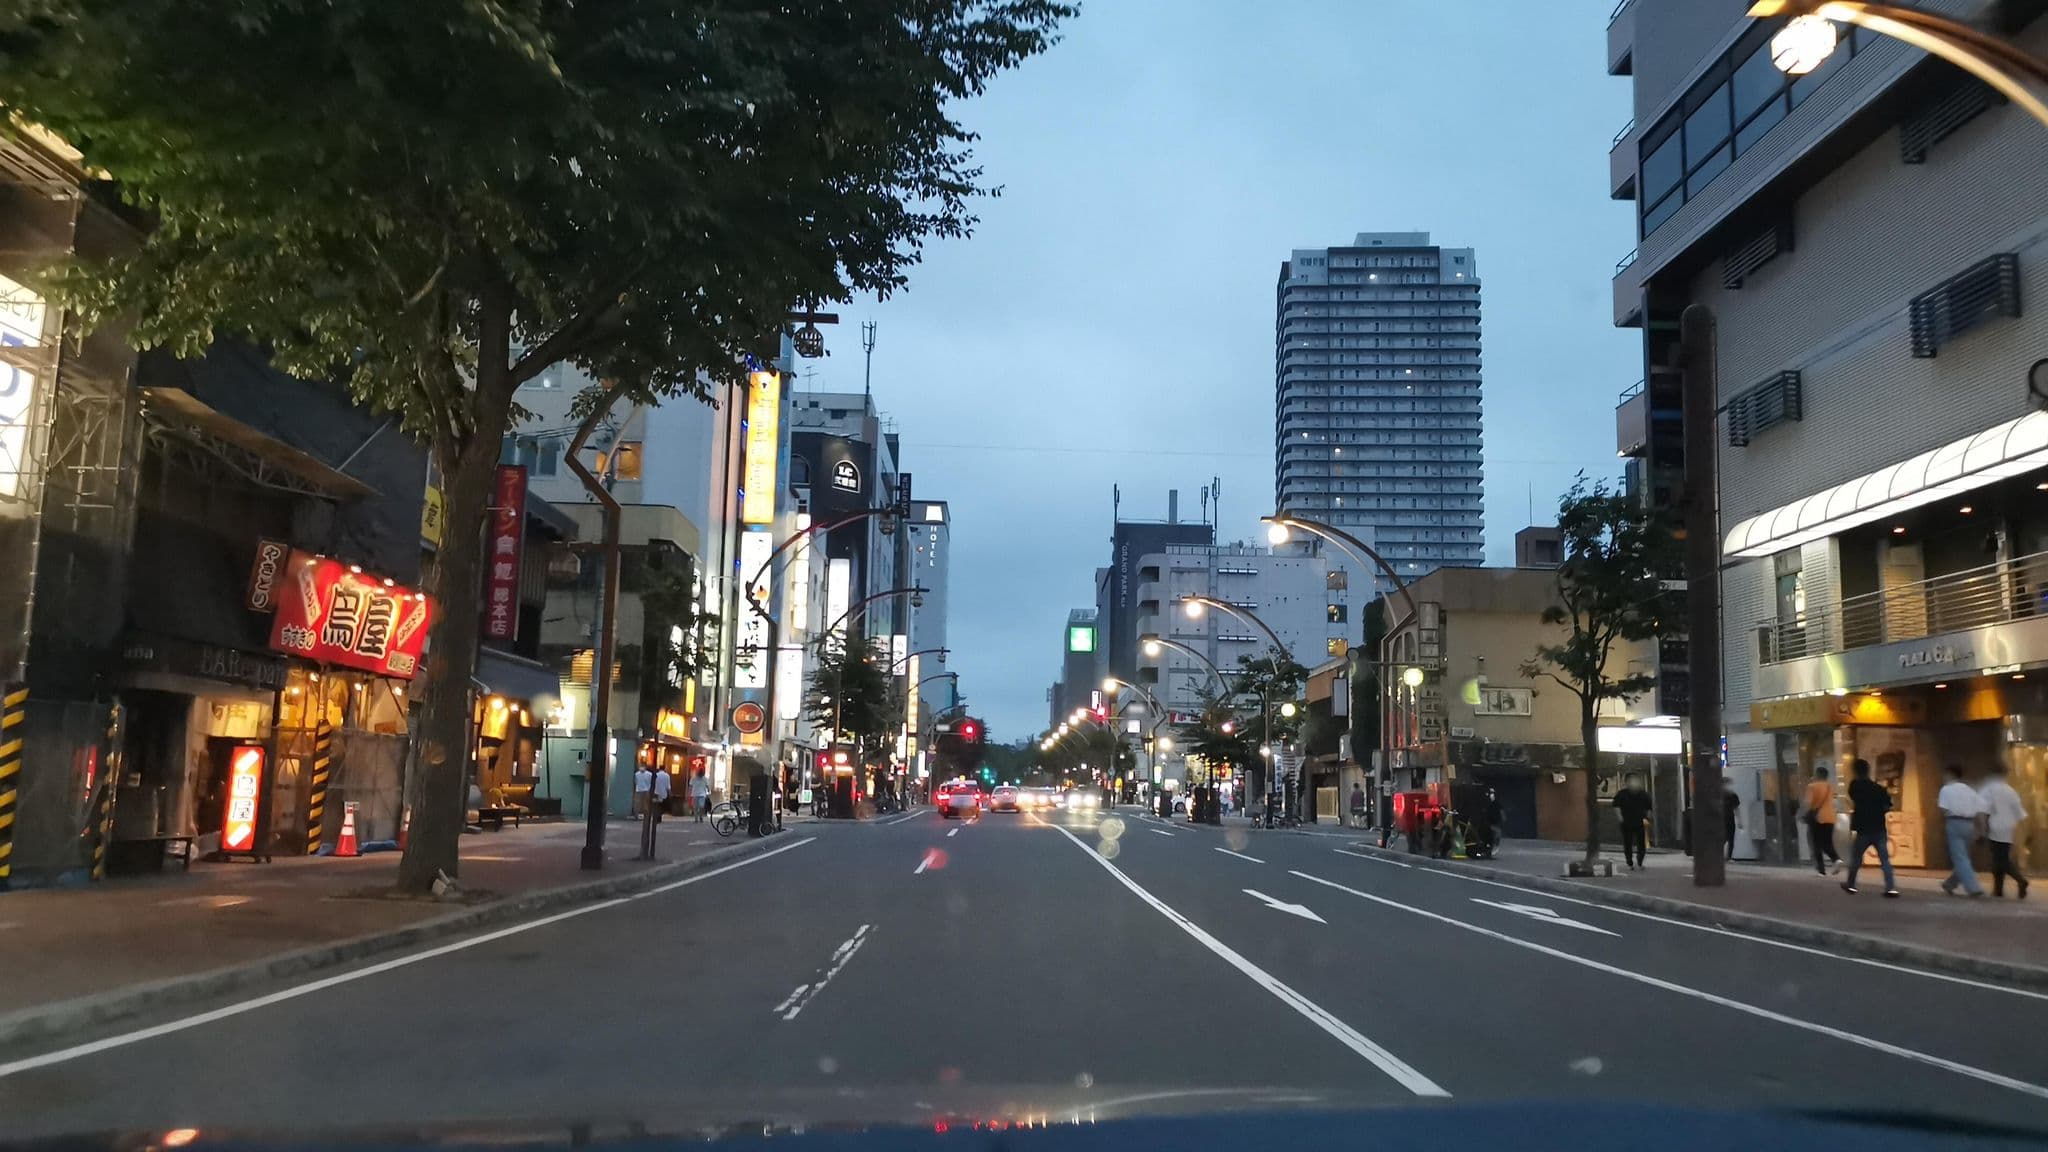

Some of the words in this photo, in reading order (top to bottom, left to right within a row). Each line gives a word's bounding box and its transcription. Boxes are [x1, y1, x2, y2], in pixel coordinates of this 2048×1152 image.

[252, 544, 281, 609] やきとり
[280, 624, 316, 650] すすきの
[322, 584, 395, 656] 鳥屋
